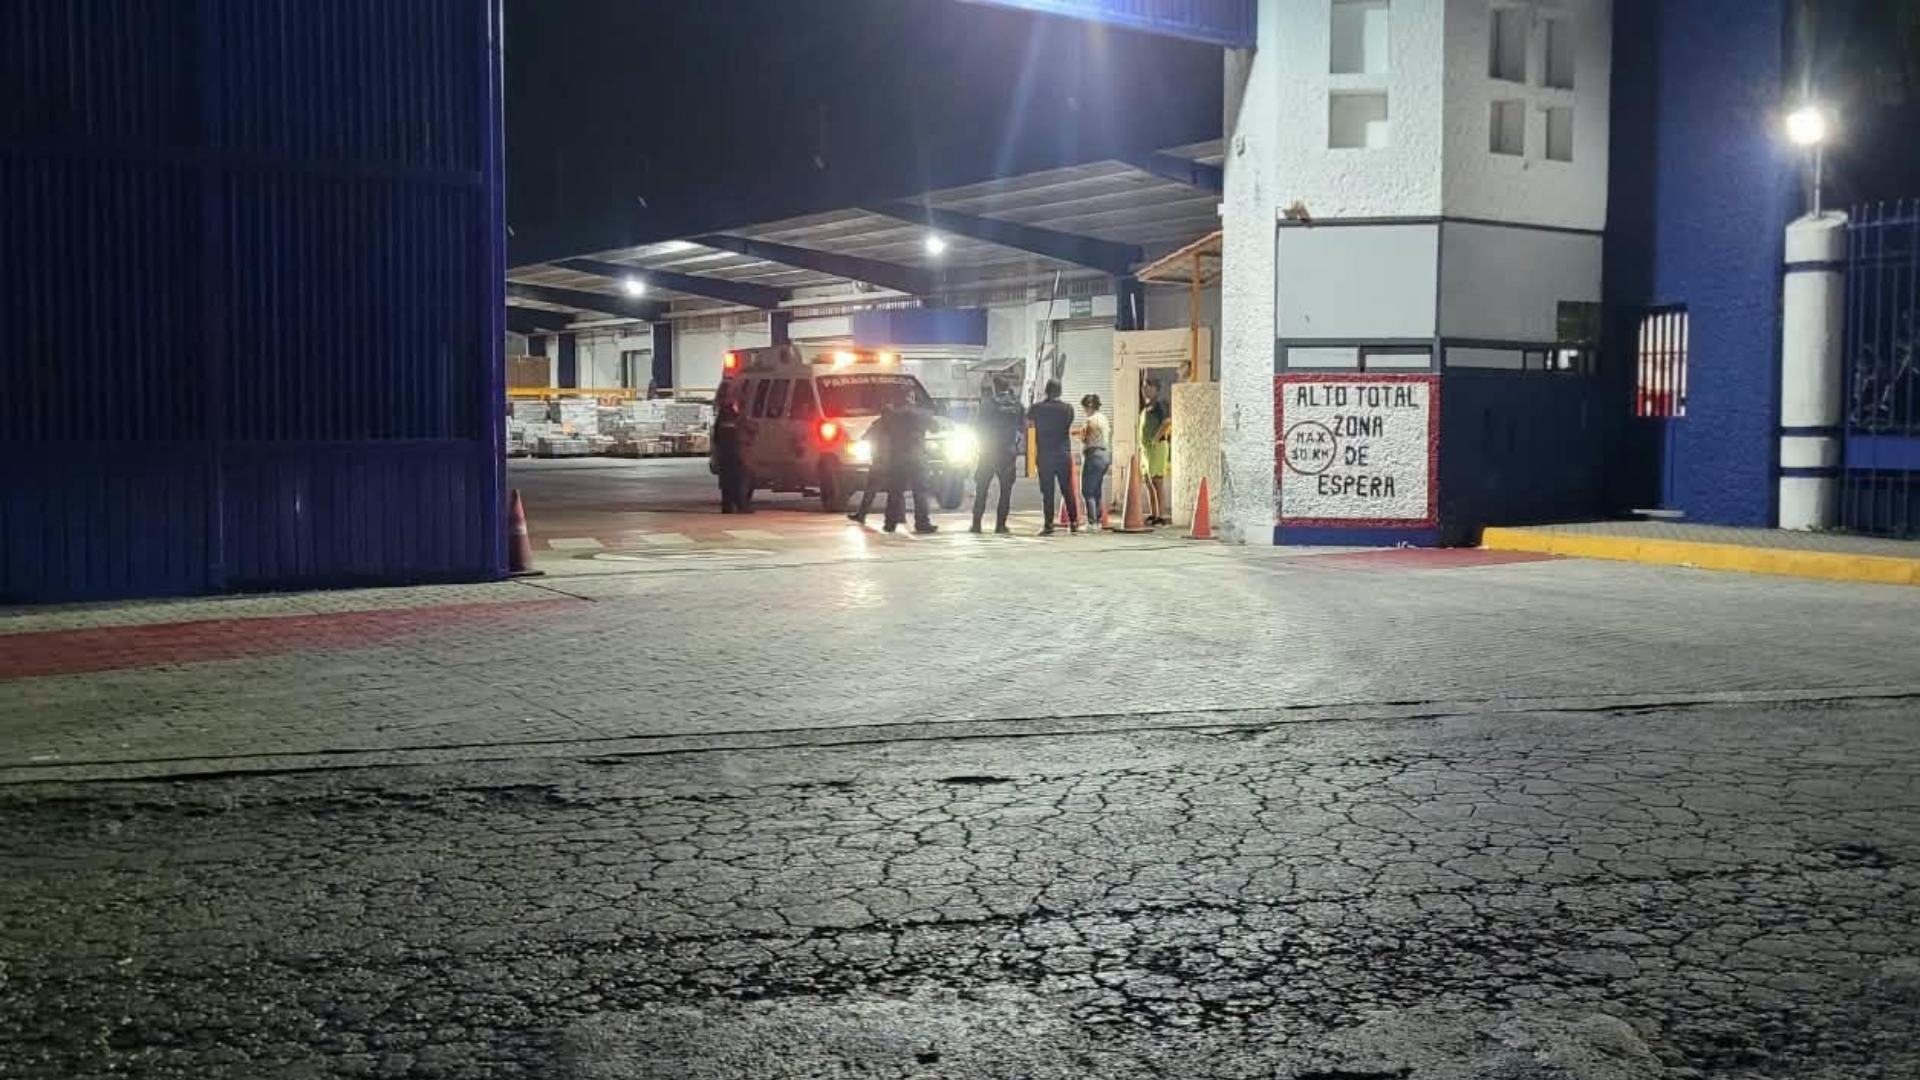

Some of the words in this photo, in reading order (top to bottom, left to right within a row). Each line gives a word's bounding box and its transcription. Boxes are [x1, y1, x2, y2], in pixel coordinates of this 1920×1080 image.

[1297, 386, 1347, 407] ALTO
[1356, 386, 1419, 409] TOTAL
[1333, 415, 1383, 437] ZONA
[1296, 432, 1325, 443] MAX
[1344, 445, 1369, 466] DE
[1318, 474, 1395, 497] ESPERA
